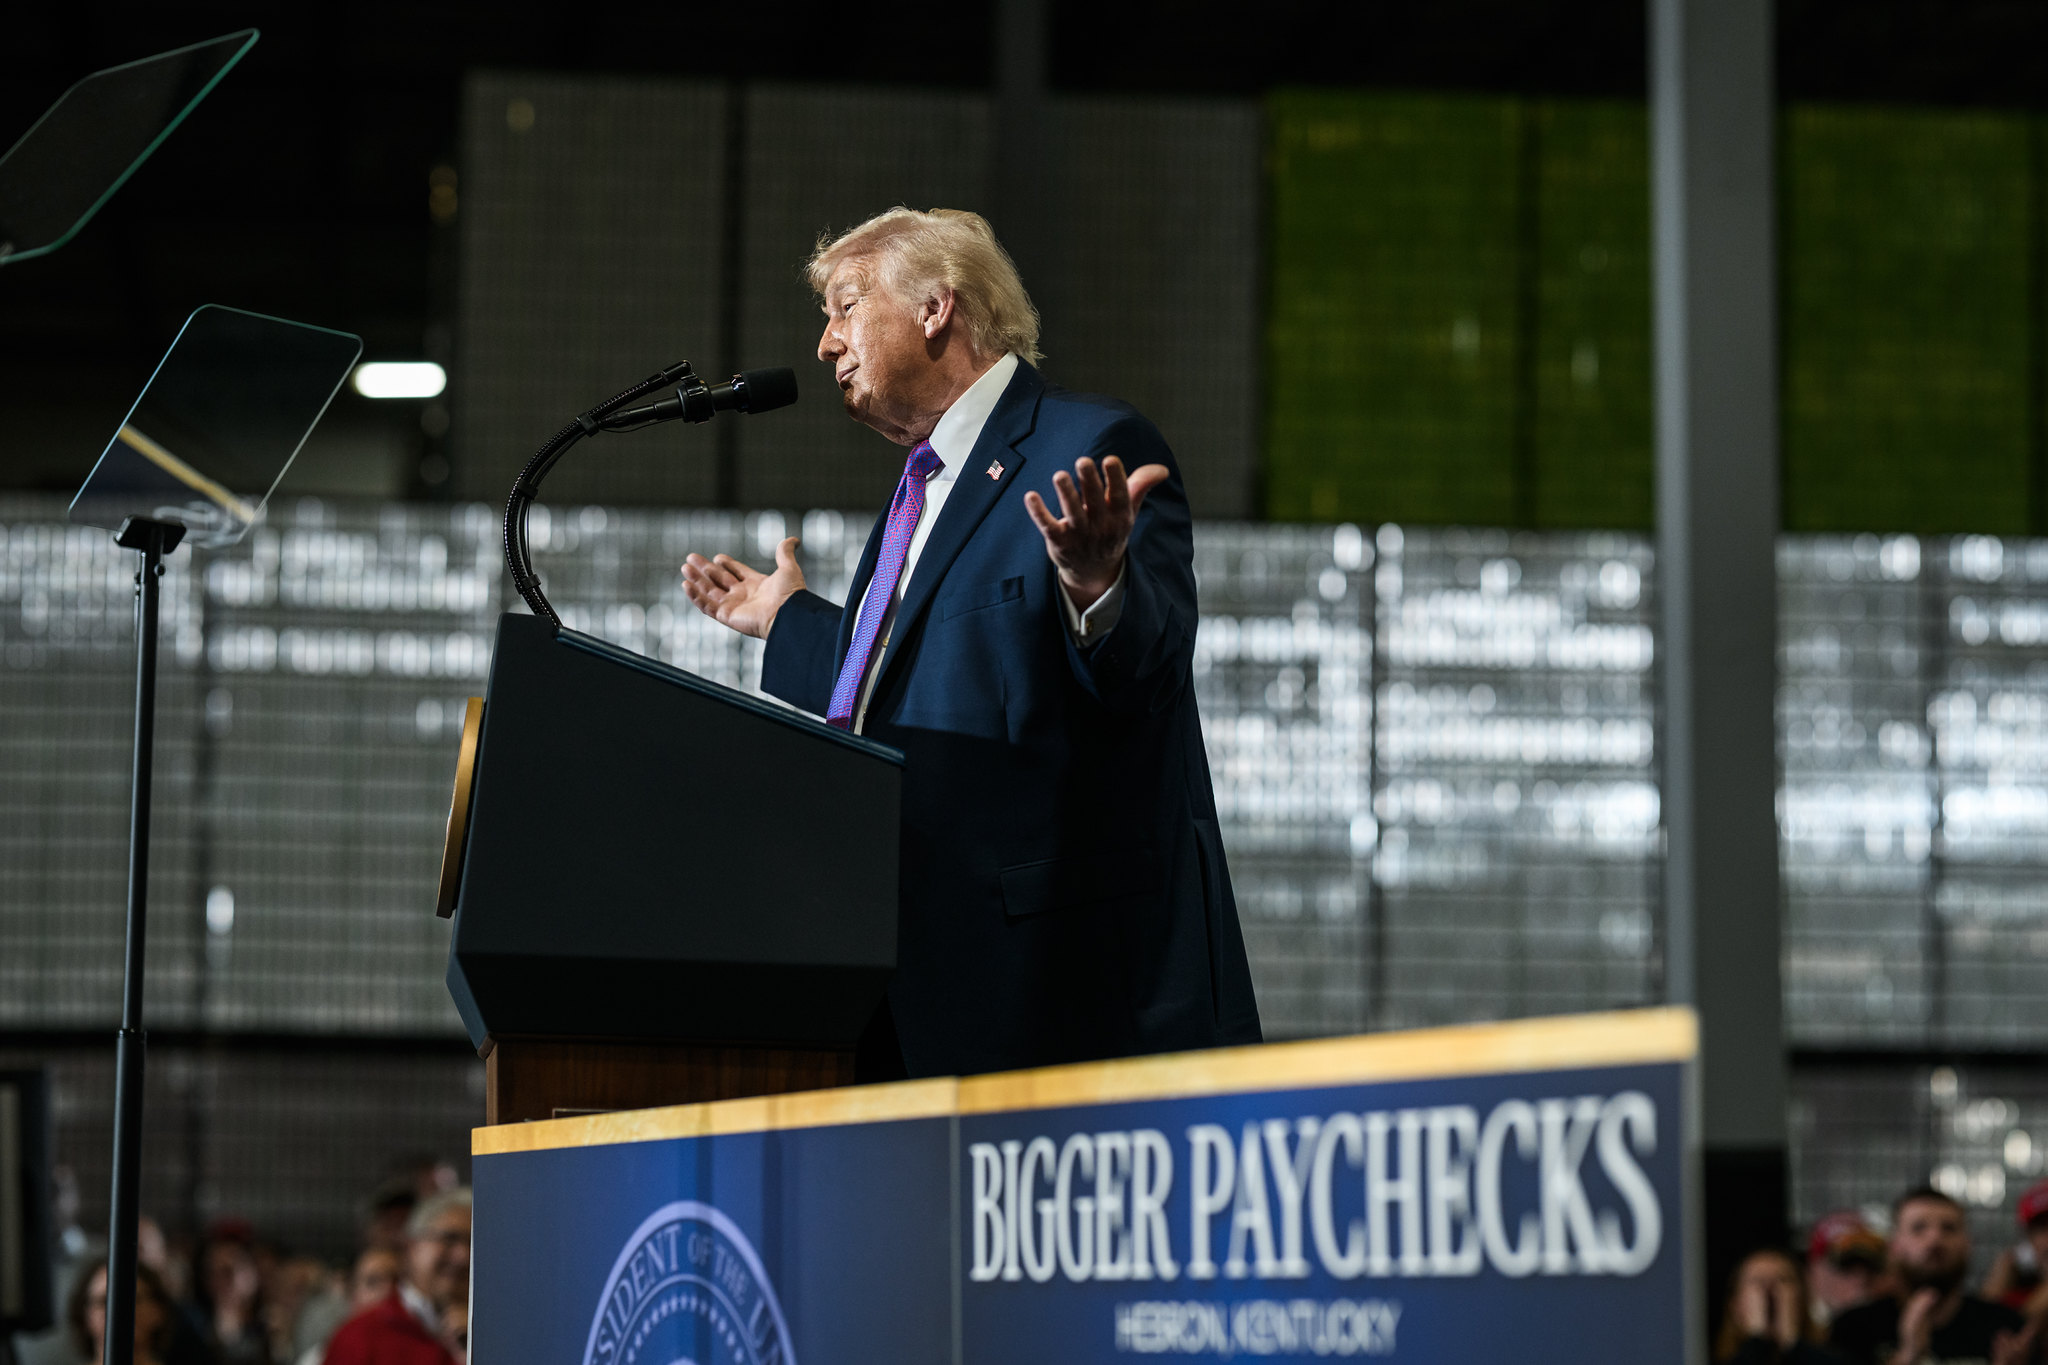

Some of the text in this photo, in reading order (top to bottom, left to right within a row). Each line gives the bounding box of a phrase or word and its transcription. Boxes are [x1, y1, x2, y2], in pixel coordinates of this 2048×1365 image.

[969, 1090, 1663, 1282] BIGGER PAYCHECKS
[687, 1231, 713, 1268] OF
[714, 1243, 749, 1306] THE
[1114, 1298, 1402, 1361] HEBRON, KENTUCKY
